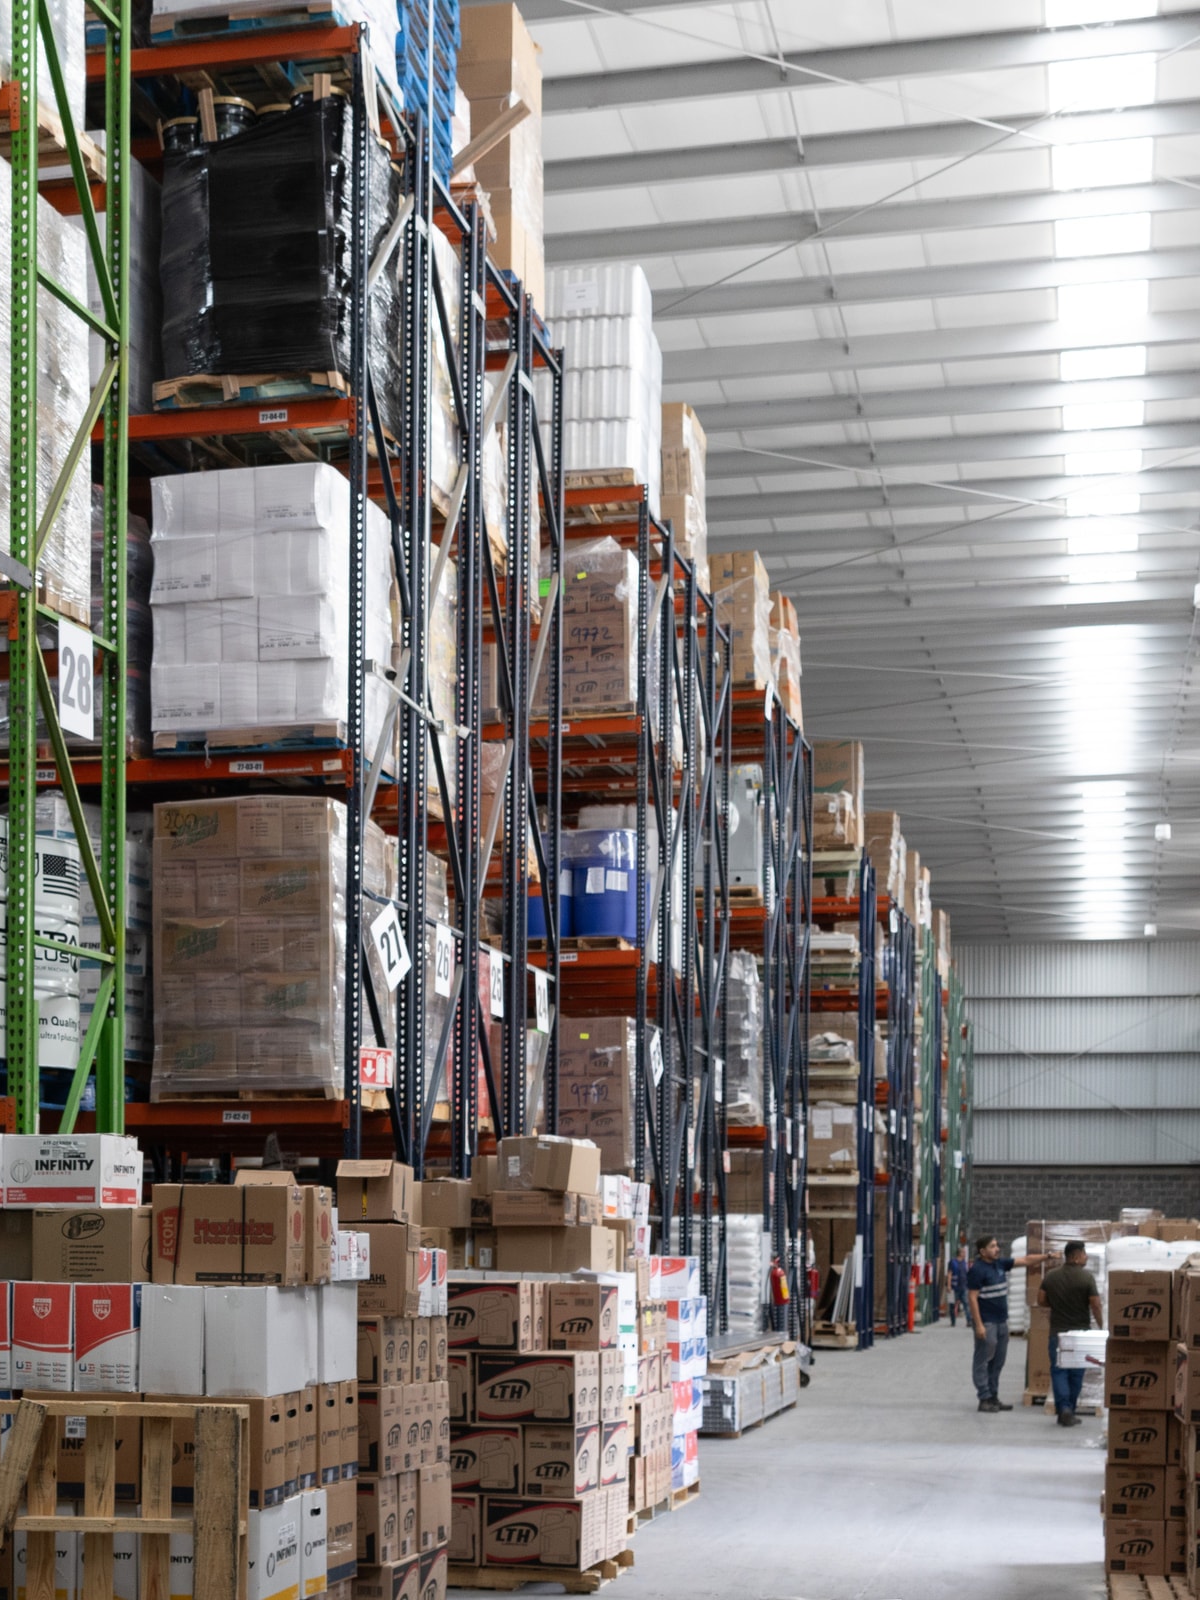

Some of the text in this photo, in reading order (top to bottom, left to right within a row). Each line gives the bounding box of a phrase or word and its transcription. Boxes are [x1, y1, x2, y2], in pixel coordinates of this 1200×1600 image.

[571, 626, 613, 643] 9772
[62, 646, 91, 714] 28
[380, 922, 402, 973] 27
[35, 948, 70, 963] LUS
[437, 940, 450, 981] 26
[491, 966, 502, 1007] 25
[35, 1159, 94, 1171] INFINITY
[113, 1164, 136, 1175] INFINITY
[163, 1216, 174, 1255] ECOM
[448, 1312, 467, 1326] TH
[1123, 1307, 1154, 1319] LTH
[560, 1322, 587, 1333] LTH
[1119, 1376, 1151, 1387] LTH
[489, 1385, 523, 1400] LTH
[1123, 1432, 1150, 1443] LTH
[449, 1455, 468, 1470] TH
[535, 1466, 564, 1478] LTH
[1120, 1487, 1148, 1498] LTH
[495, 1529, 530, 1545] LTH
[276, 1542, 297, 1562] INFINITY
[1119, 1543, 1147, 1555] LTH
